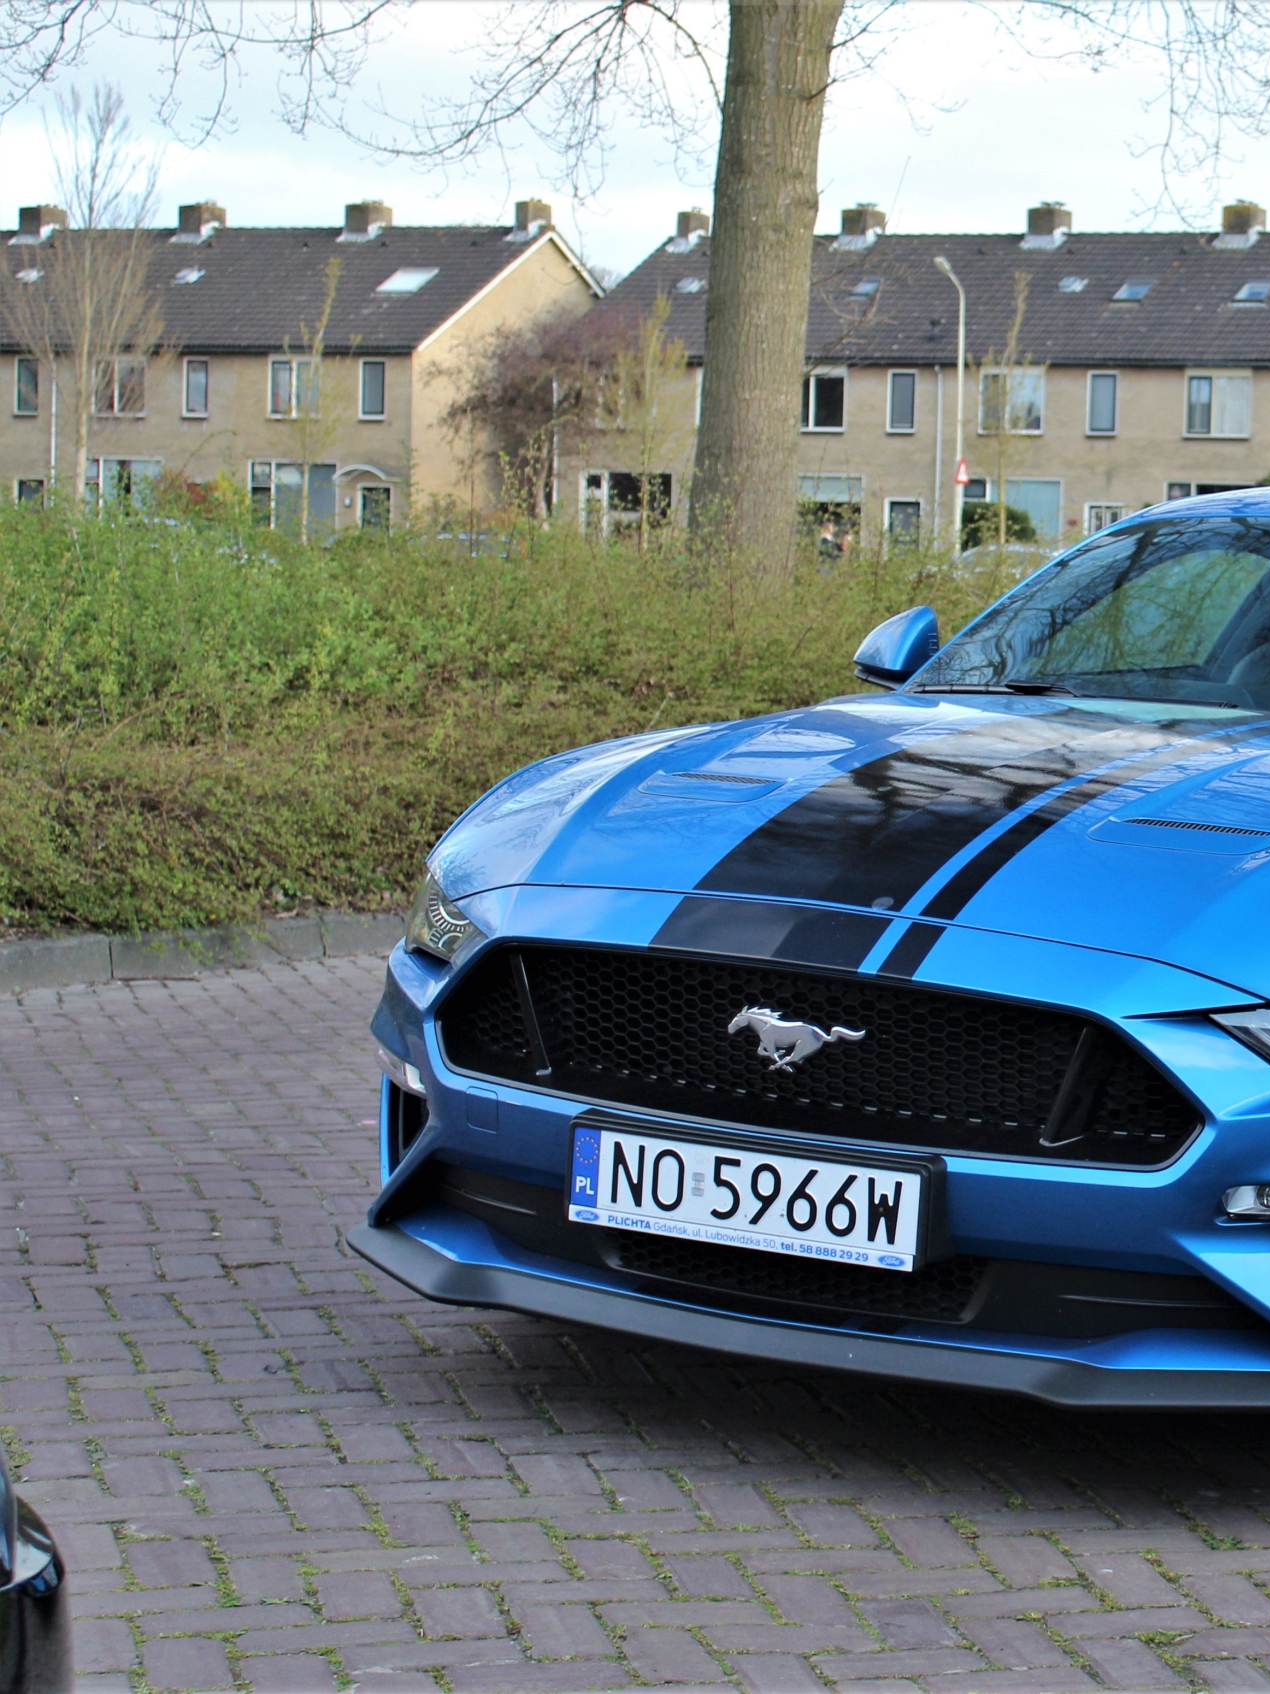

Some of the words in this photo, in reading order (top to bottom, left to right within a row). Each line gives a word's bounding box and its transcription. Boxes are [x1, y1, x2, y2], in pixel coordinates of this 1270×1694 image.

[575, 1176, 595, 1195] PL
[611, 1141, 685, 1212] NO
[711, 1156, 902, 1245] 5966W
[577, 1210, 597, 1221] Ford
[608, 1215, 651, 1230] PLICHTA
[653, 1222, 690, 1236] Gdańsk,
[692, 1230, 703, 1238] ul.
[705, 1230, 761, 1247] Lubowidzka
[762, 1238, 779, 1250] 50,
[780, 1242, 798, 1252] tel.
[799, 1244, 813, 1254] 58
[815, 1246, 837, 1258] 888
[839, 1249, 853, 1260] 29
[854, 1252, 869, 1262] 29
[880, 1255, 903, 1267] Ford
